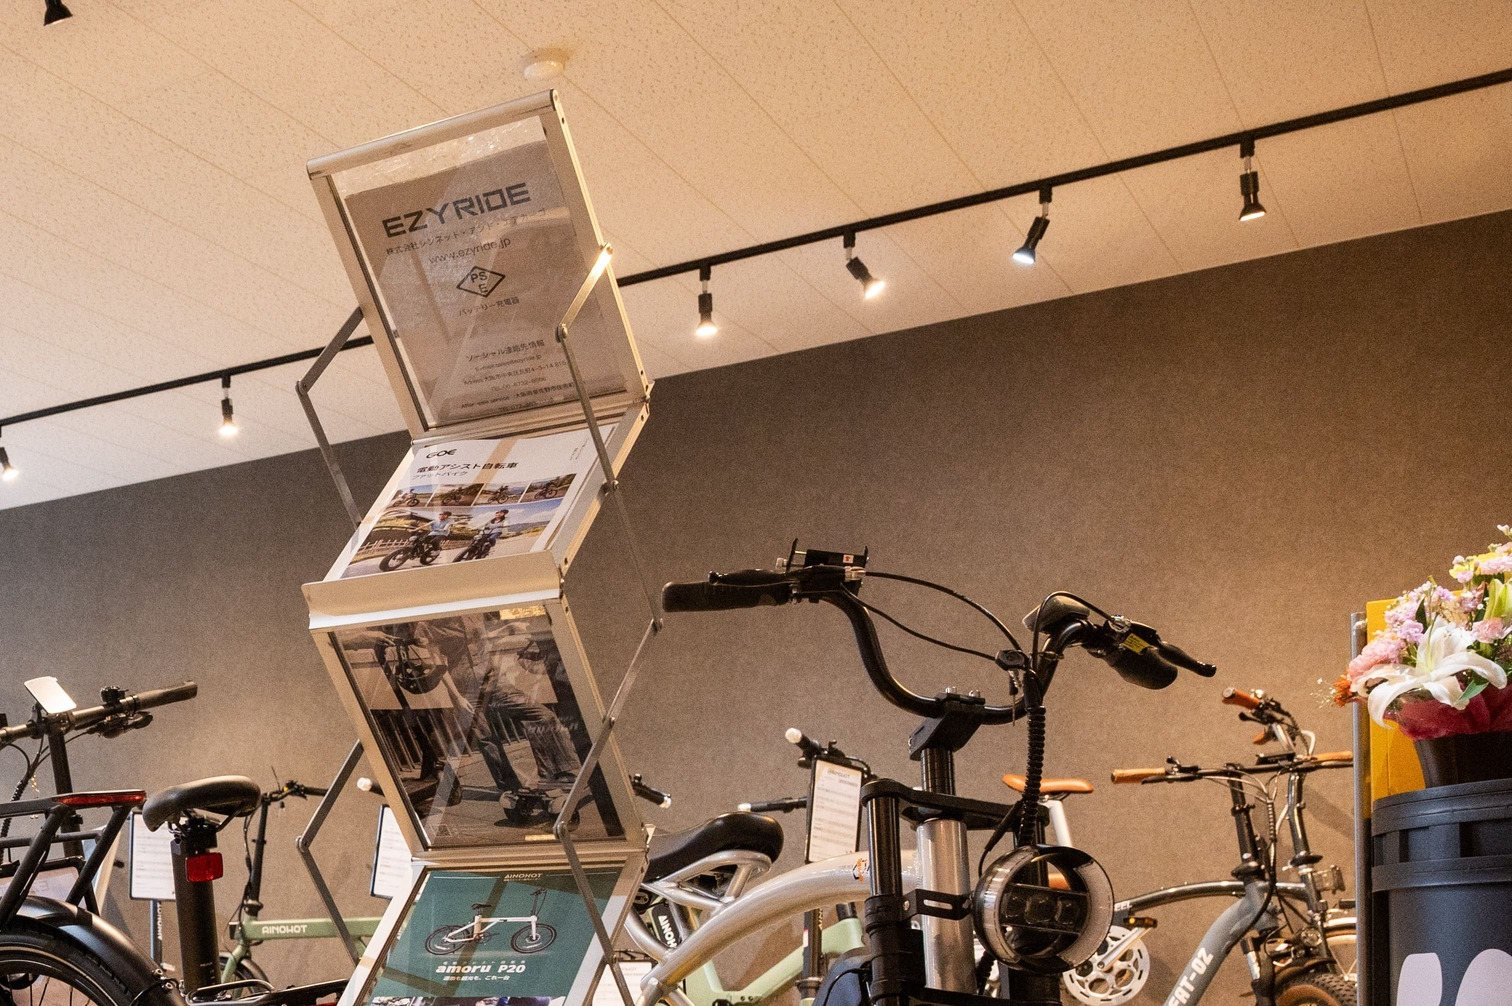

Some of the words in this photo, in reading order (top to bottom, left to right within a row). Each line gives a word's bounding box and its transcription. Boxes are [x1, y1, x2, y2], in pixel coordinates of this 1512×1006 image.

[381, 182, 532, 239] EZYRIDE
[428, 236, 512, 264] www.ezyride.jp
[416, 461, 520, 474] 電動アシスト自転車
[411, 470, 469, 481] ファットバイク
[1114, 900, 1133, 912] EEL
[261, 924, 307, 934] AINOHOT
[435, 964, 491, 973] amoru
[497, 964, 526, 973] P20
